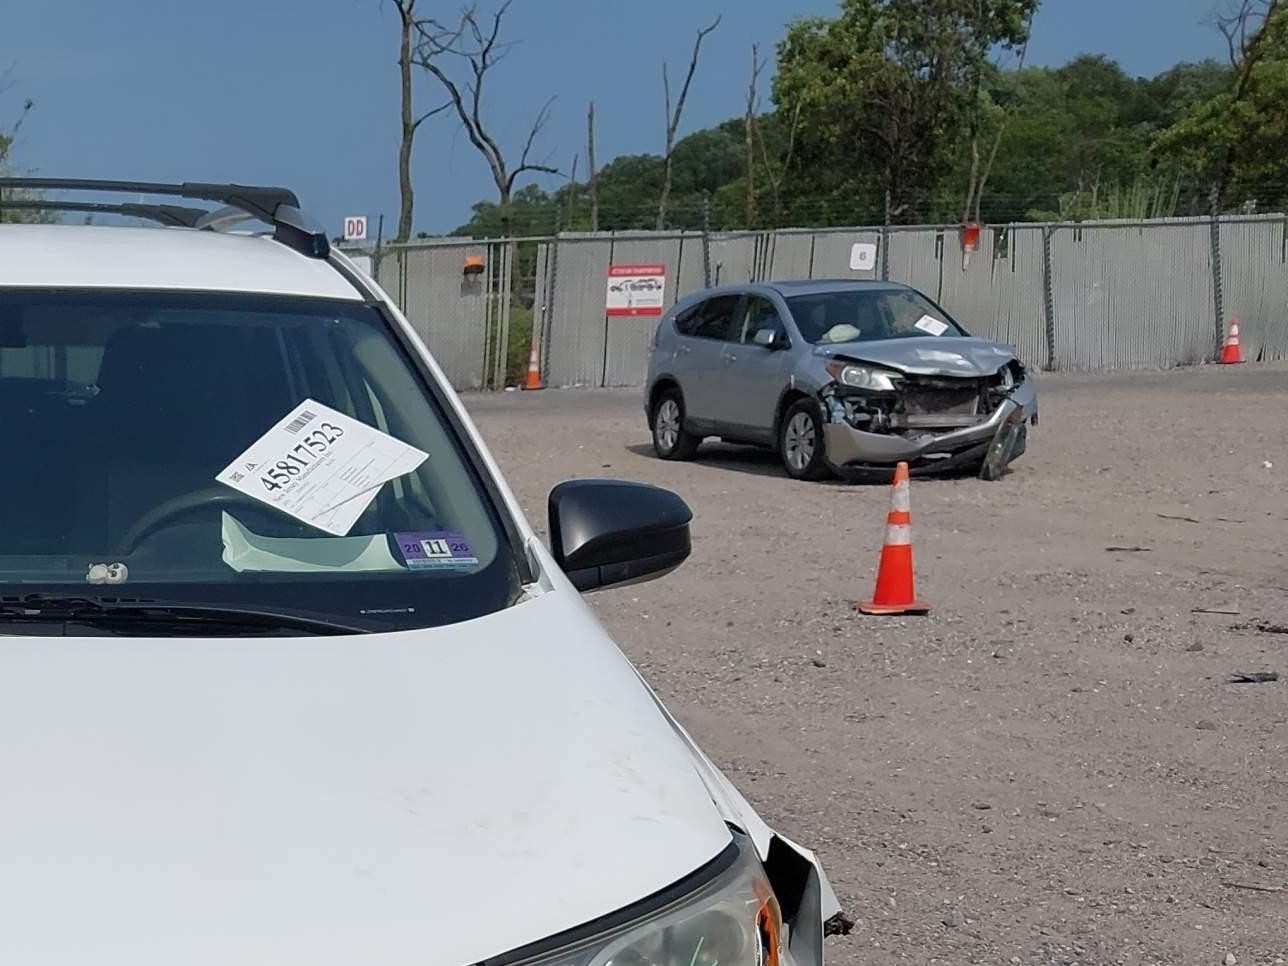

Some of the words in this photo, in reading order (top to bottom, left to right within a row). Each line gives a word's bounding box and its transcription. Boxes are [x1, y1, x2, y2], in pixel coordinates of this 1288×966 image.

[347, 219, 364, 237] DD
[261, 423, 345, 492] 45817523
[404, 543, 421, 553] 20
[425, 540, 447, 555] 11
[451, 543, 469, 552] 26
